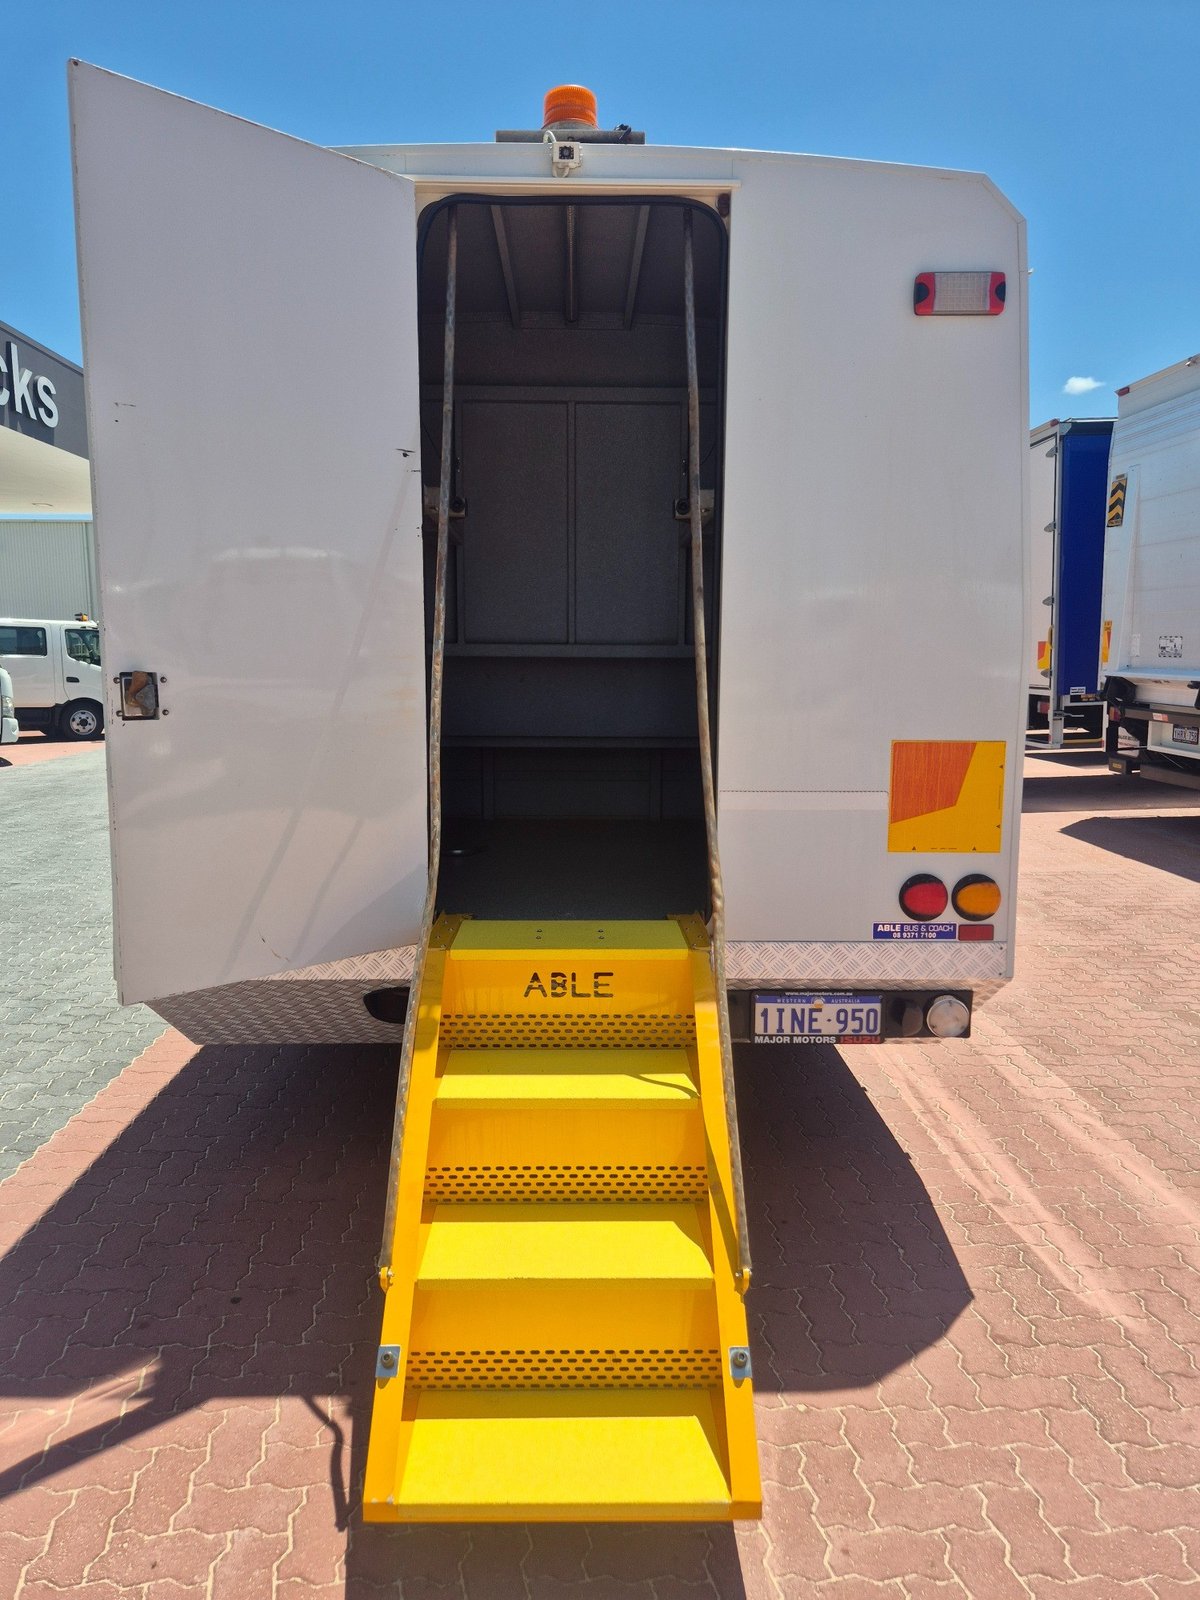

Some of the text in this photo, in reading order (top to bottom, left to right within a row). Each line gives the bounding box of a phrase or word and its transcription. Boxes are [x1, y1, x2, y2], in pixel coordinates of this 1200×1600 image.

[877, 924, 954, 932] ABLE BUS & COACH
[523, 972, 614, 998] ABLE
[754, 1035, 881, 1044] MAJOR MOTORS ISUZU
